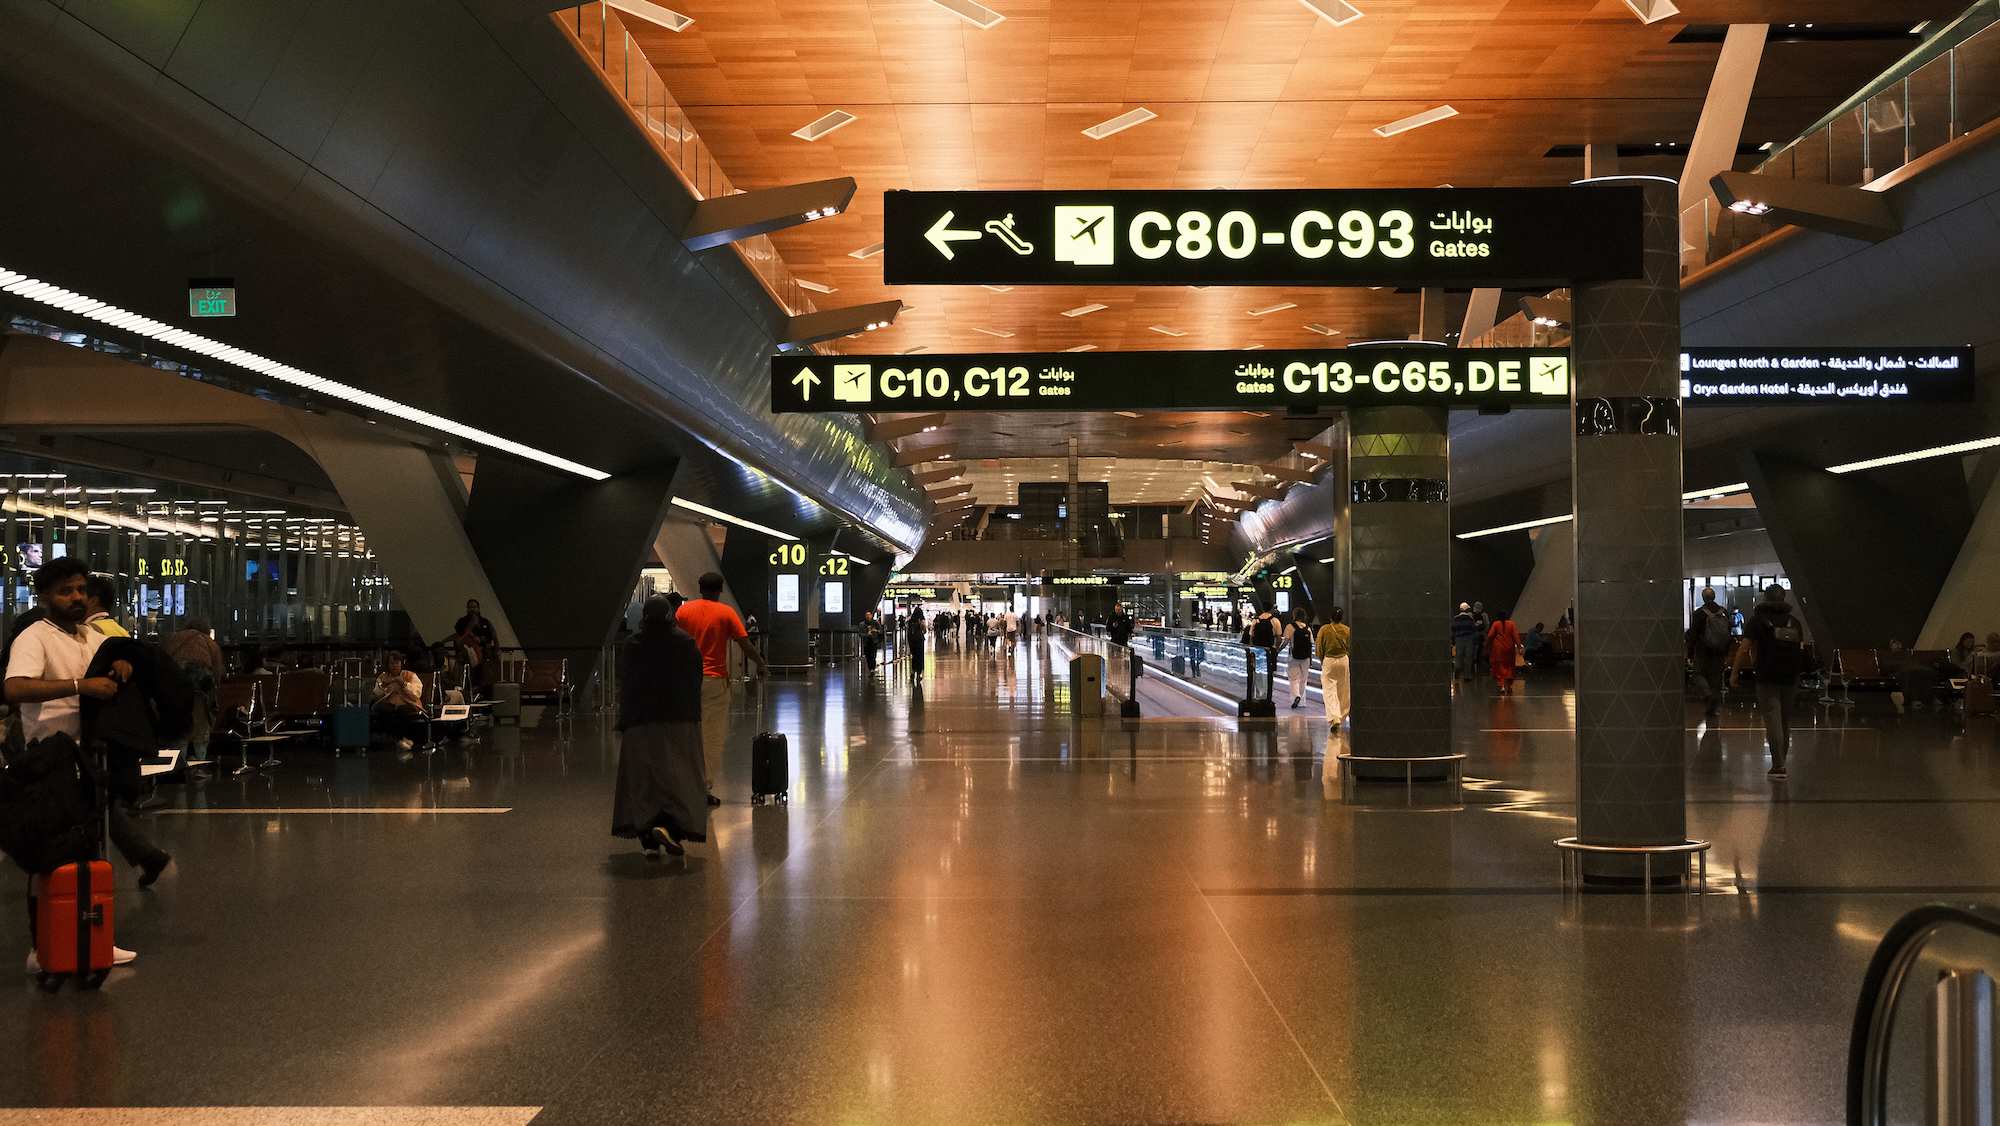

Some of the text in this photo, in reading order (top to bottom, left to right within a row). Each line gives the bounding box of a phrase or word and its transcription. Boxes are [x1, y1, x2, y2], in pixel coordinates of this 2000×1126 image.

[1429, 211, 1492, 235] بوابات
[1129, 210, 1414, 259] C80-C93
[1429, 239, 1490, 258] Gates
[199, 300, 227, 314] EXIT
[1692, 357, 1738, 372] Lounges
[1738, 356, 1770, 369] North
[1770, 357, 1780, 369] &
[1780, 356, 1820, 369] Garden
[1827, 355, 1873, 371] والحديقة
[1874, 355, 1907, 372] شمال
[1914, 355, 1959, 370] الصالات
[1038, 366, 1075, 382] بوابات
[1235, 363, 1274, 380] بوابات
[1283, 361, 1521, 396] C13-C65,DE
[879, 367, 1029, 402] C10,C12
[1038, 385, 1072, 396] Gates
[1236, 382, 1274, 394] Gates
[1692, 383, 1719, 397] Oryx
[1719, 382, 1758, 395] Garden
[1759, 382, 1790, 395] Hotel
[1796, 379, 1909, 398] فندق أوريكس الحديقة
